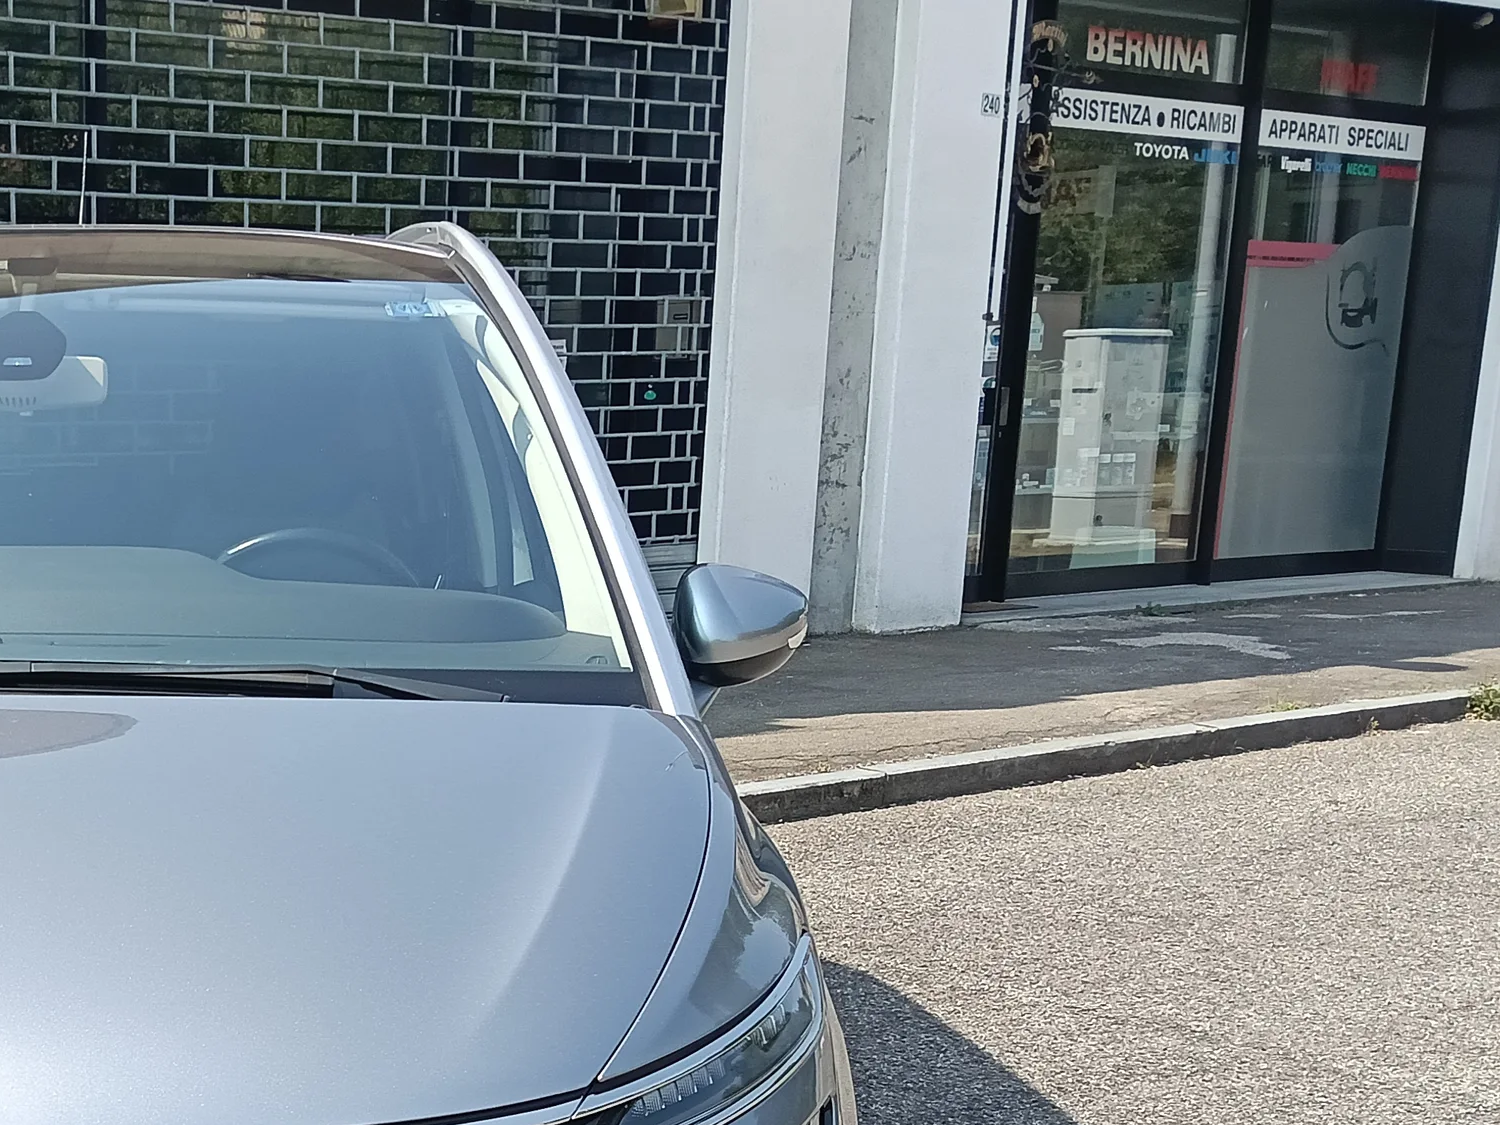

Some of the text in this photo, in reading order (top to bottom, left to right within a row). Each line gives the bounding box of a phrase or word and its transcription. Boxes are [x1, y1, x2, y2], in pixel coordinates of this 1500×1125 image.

[1086, 24, 1209, 75] BERNINA
[983, 94, 1000, 115] 240
[1050, 97, 1237, 135] ASSISTENZA RICAMBI
[1268, 118, 1410, 152] APPARATI SPECIALI
[1134, 142, 1189, 161] TOYOTA
[1346, 162, 1378, 177] NECCHI
